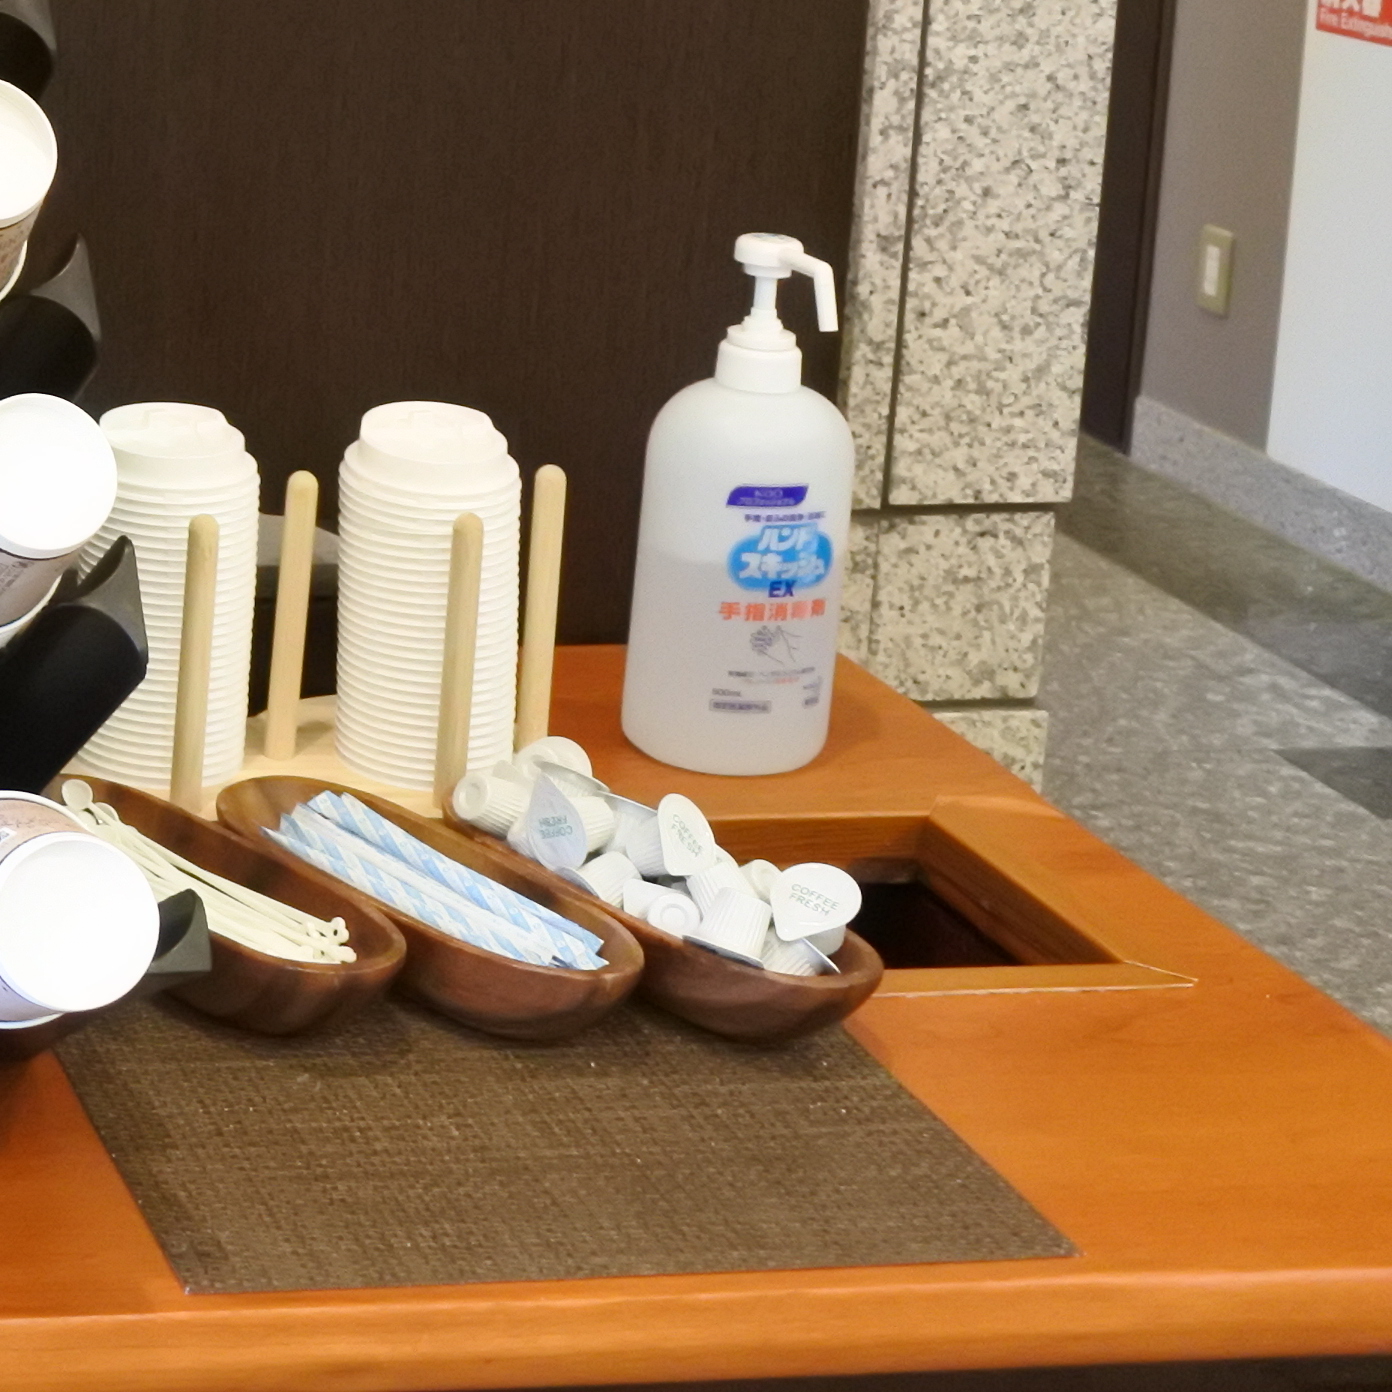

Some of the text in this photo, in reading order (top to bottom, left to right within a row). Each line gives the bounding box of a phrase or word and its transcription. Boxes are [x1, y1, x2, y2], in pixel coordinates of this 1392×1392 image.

[768, 580, 796, 598] EX
[671, 823, 699, 858] FRESH
[672, 813, 703, 851] COFFEE
[788, 892, 830, 916] FRESH
[791, 882, 840, 911] COFFEE
